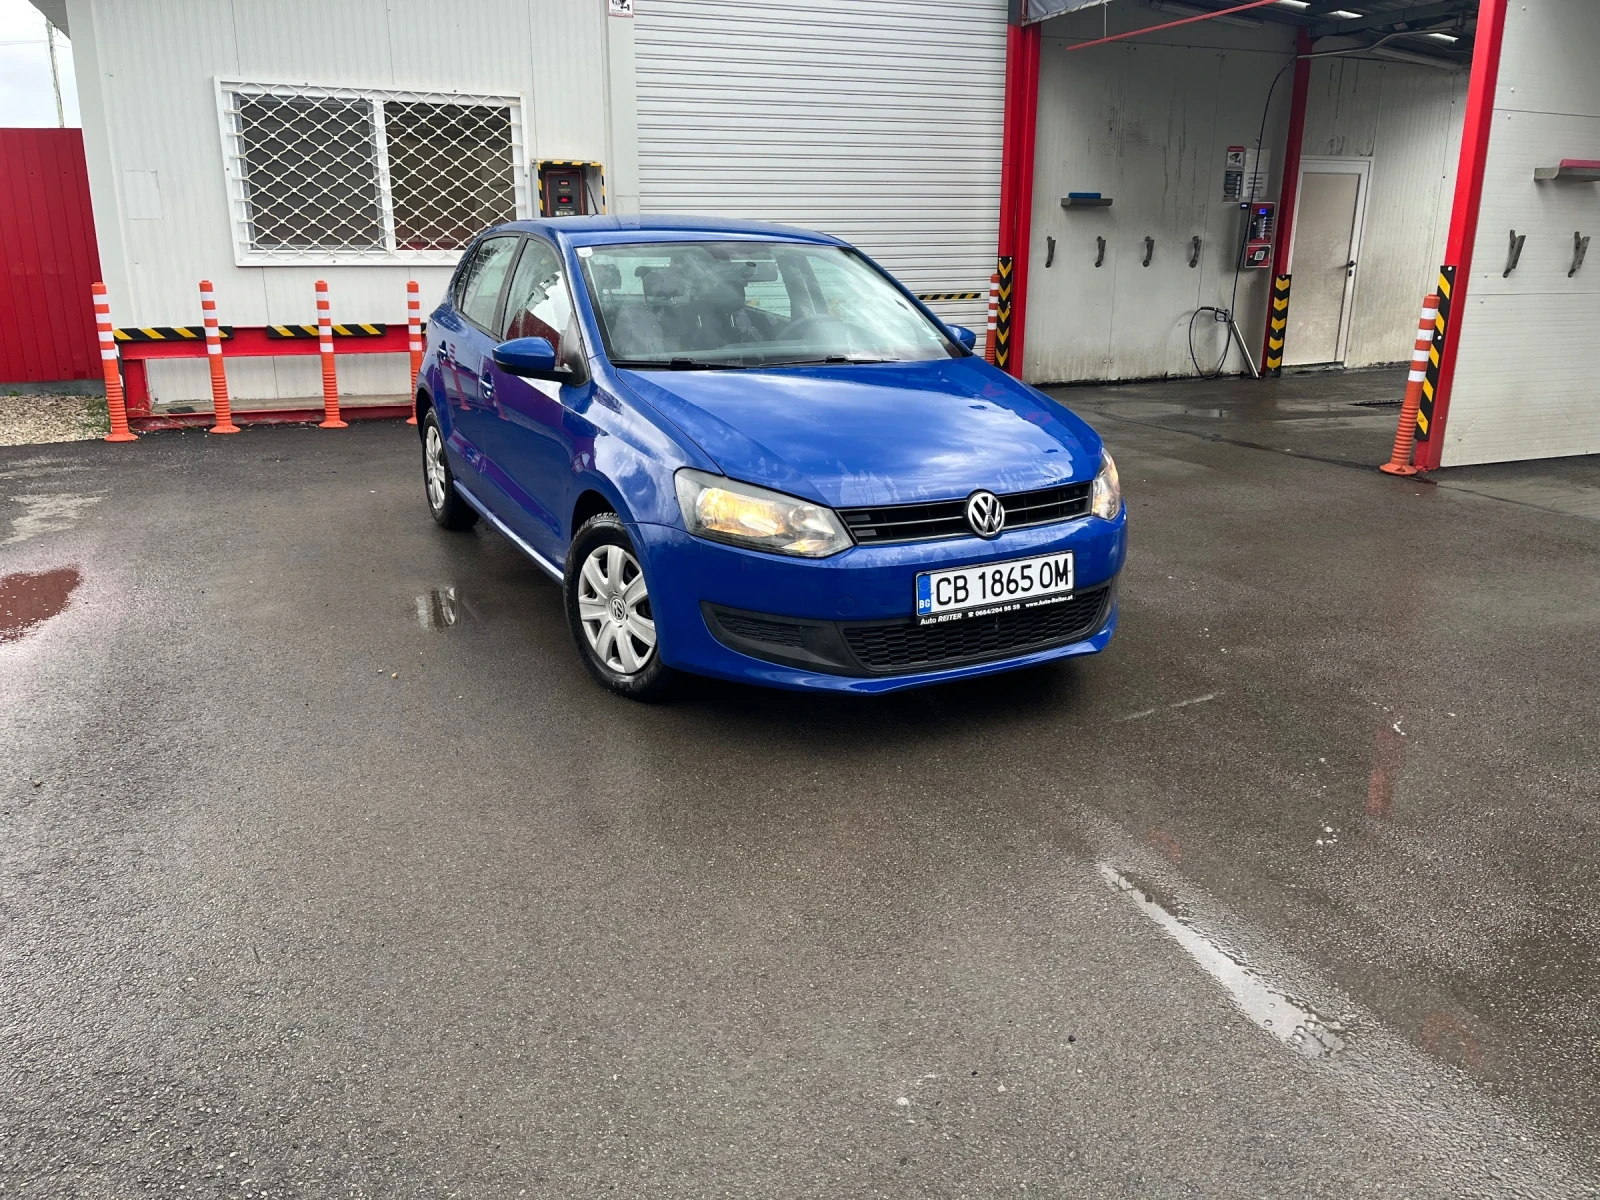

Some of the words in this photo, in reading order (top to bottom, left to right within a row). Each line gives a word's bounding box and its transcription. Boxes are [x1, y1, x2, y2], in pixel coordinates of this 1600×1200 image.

[968, 492, 1005, 537] VW
[936, 575, 970, 606] CB
[978, 564, 1034, 600] 1865
[1039, 558, 1069, 589] OM
[919, 598, 931, 609] BG
[920, 617, 937, 626] Auto
[937, 612, 963, 623] REITER
[1025, 594, 1074, 608] www.Auto-Reiter.at
